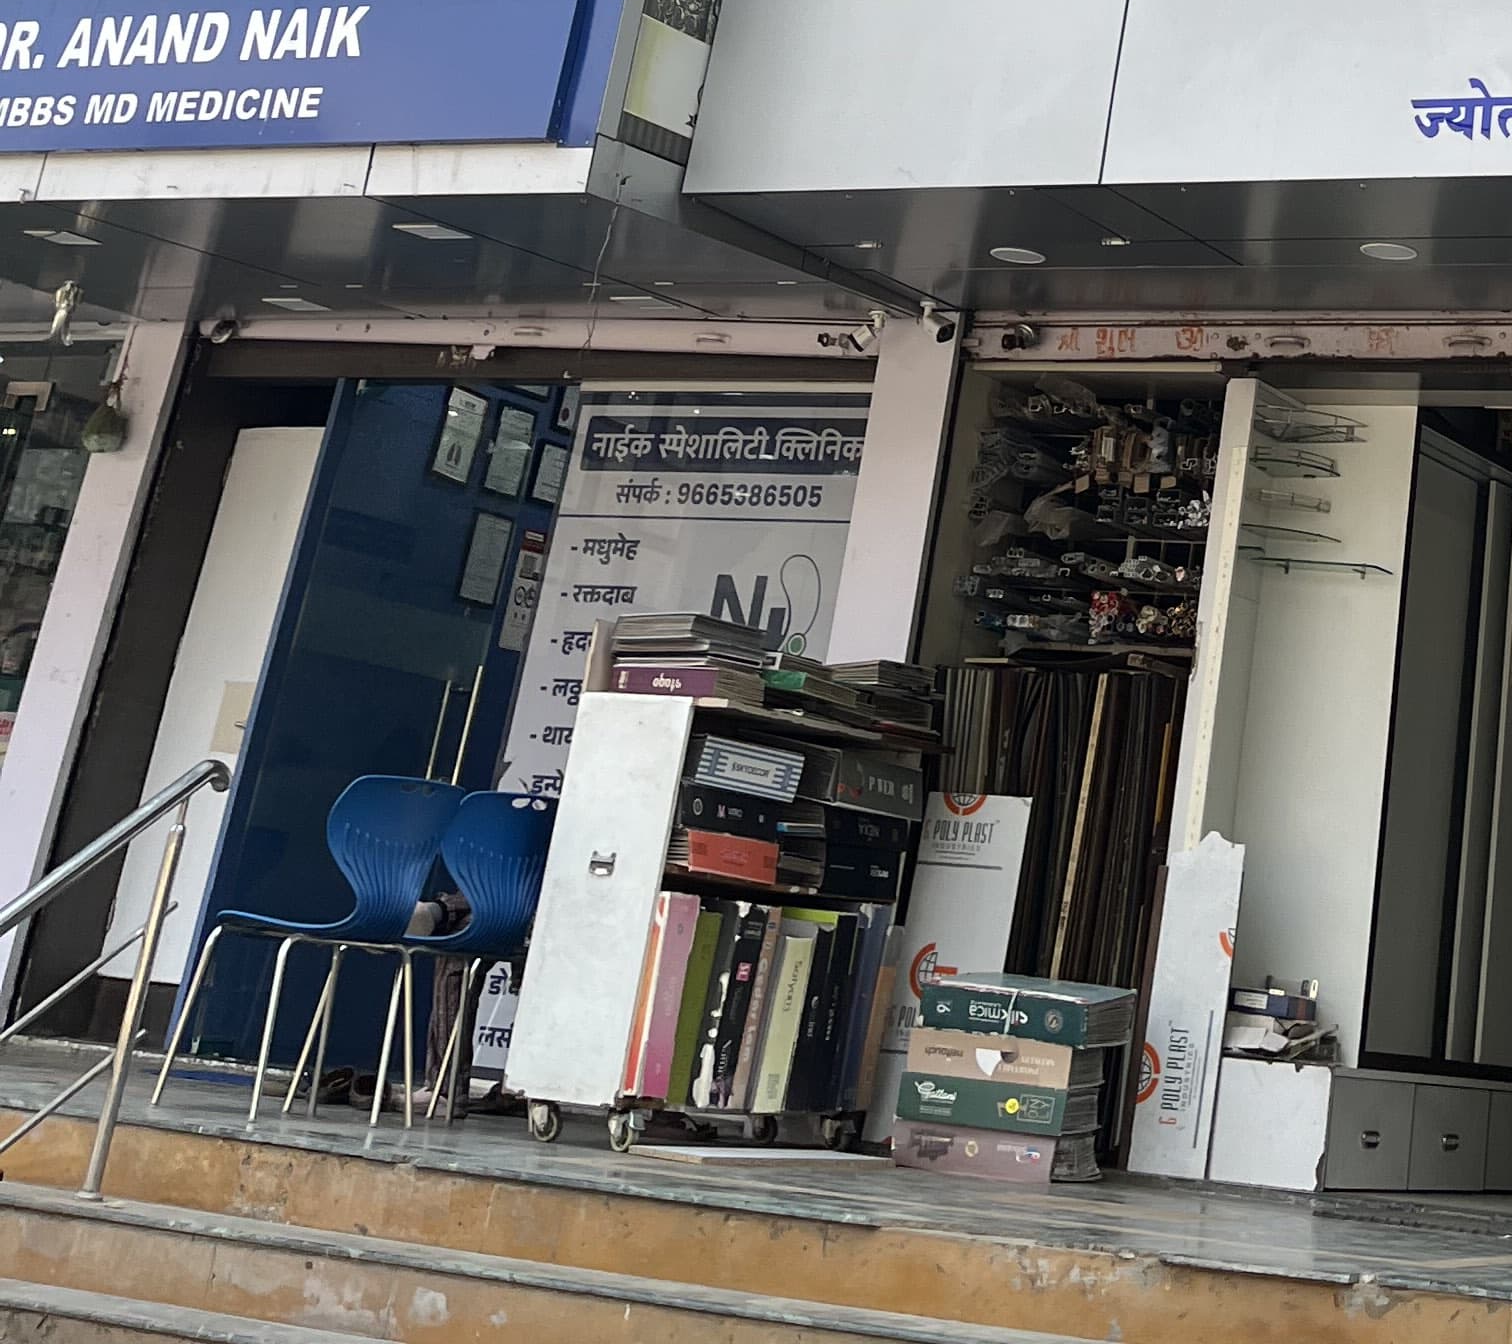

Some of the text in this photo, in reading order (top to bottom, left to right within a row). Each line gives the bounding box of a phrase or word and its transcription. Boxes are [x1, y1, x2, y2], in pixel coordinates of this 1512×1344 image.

[0, 5, 371, 71] R. ANAND NAIK
[83, 92, 137, 125] MD
[145, 87, 325, 123] MEDICINE
[591, 426, 864, 463] नाईक स्पेशालिटी क्लिनिक
[615, 478, 824, 509] संपर्क 9665386505
[582, 535, 641, 566] मधुमेह
[573, 583, 638, 606] रक्तदाब
